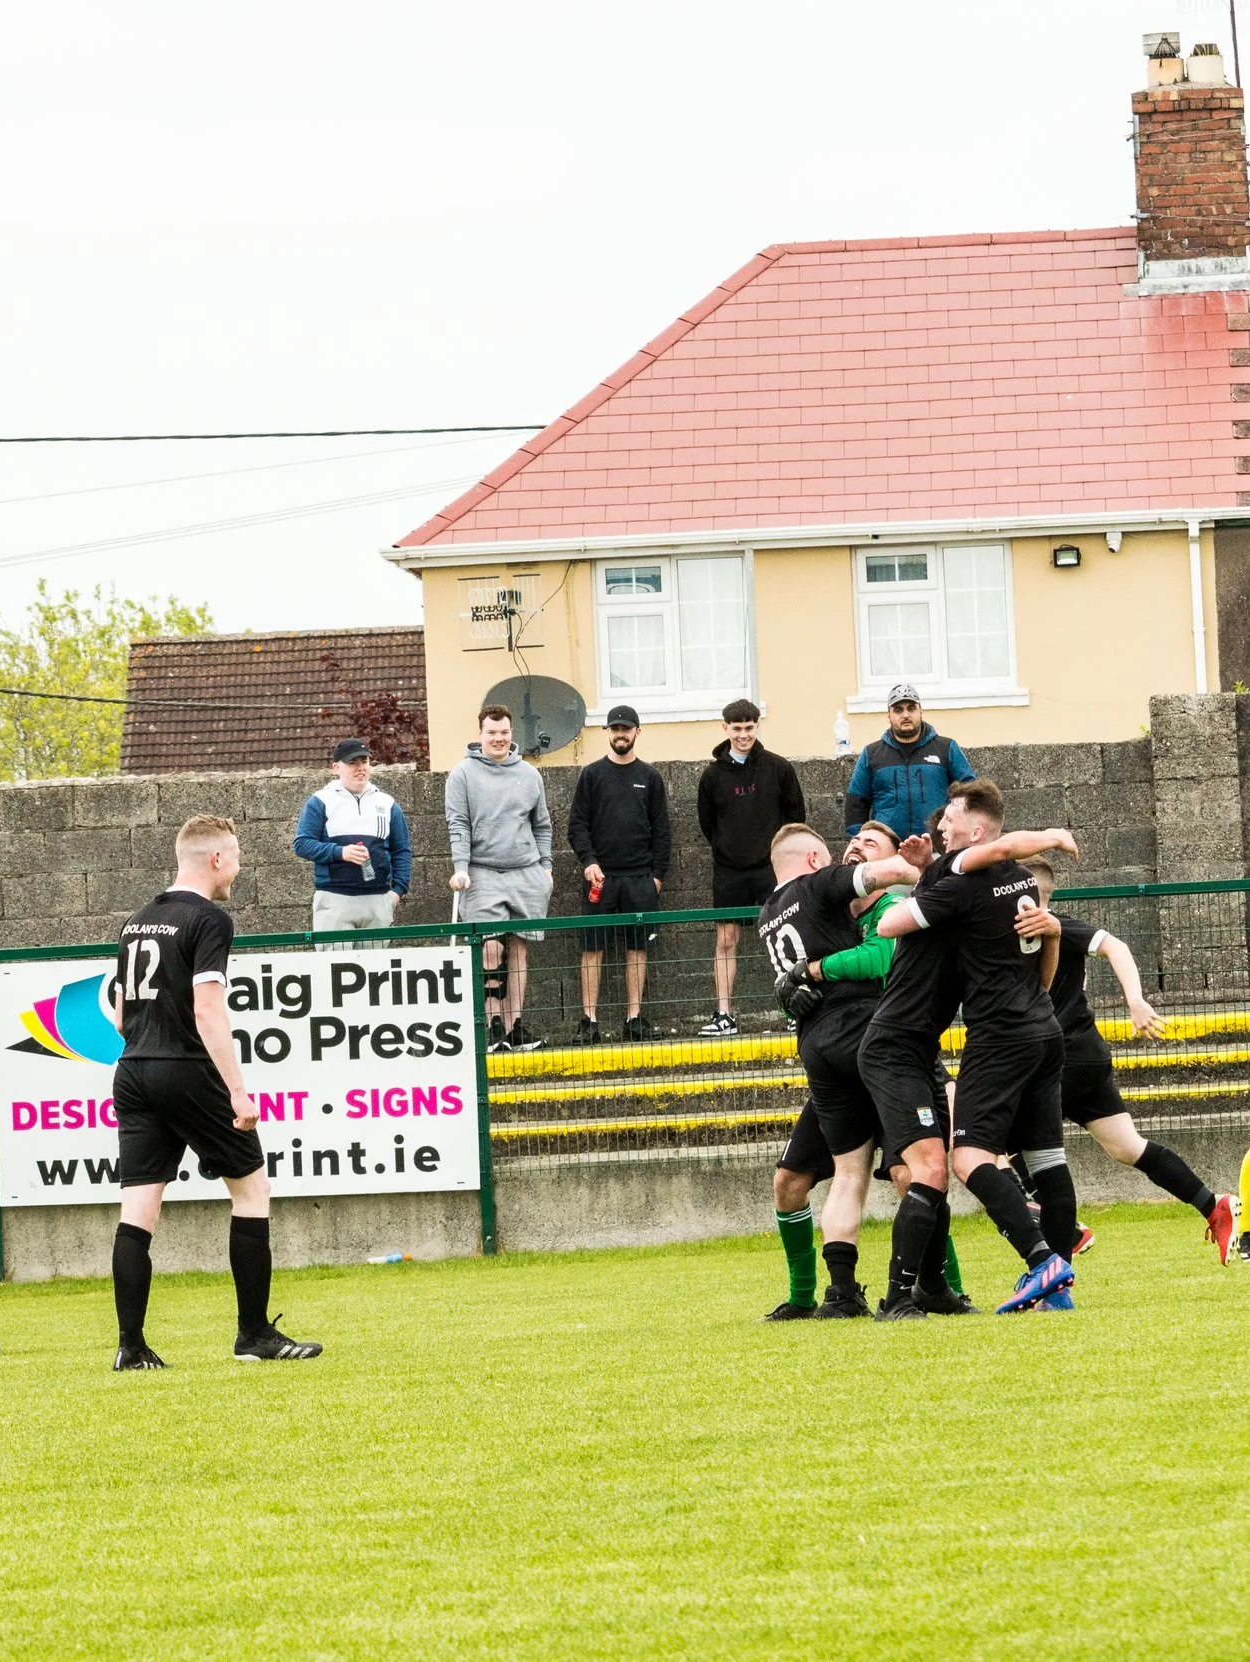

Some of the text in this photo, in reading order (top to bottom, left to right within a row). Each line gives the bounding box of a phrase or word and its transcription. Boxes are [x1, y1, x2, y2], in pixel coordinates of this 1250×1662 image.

[1026, 876, 1039, 887] CO
[157, 924, 179, 936] COW
[765, 923, 807, 980] 10
[125, 939, 161, 1000] 12
[332, 959, 463, 1006] Print
[310, 1015, 464, 1065] Press
[12, 1097, 118, 1131] DESIG
[346, 1085, 464, 1119] SIGNS
